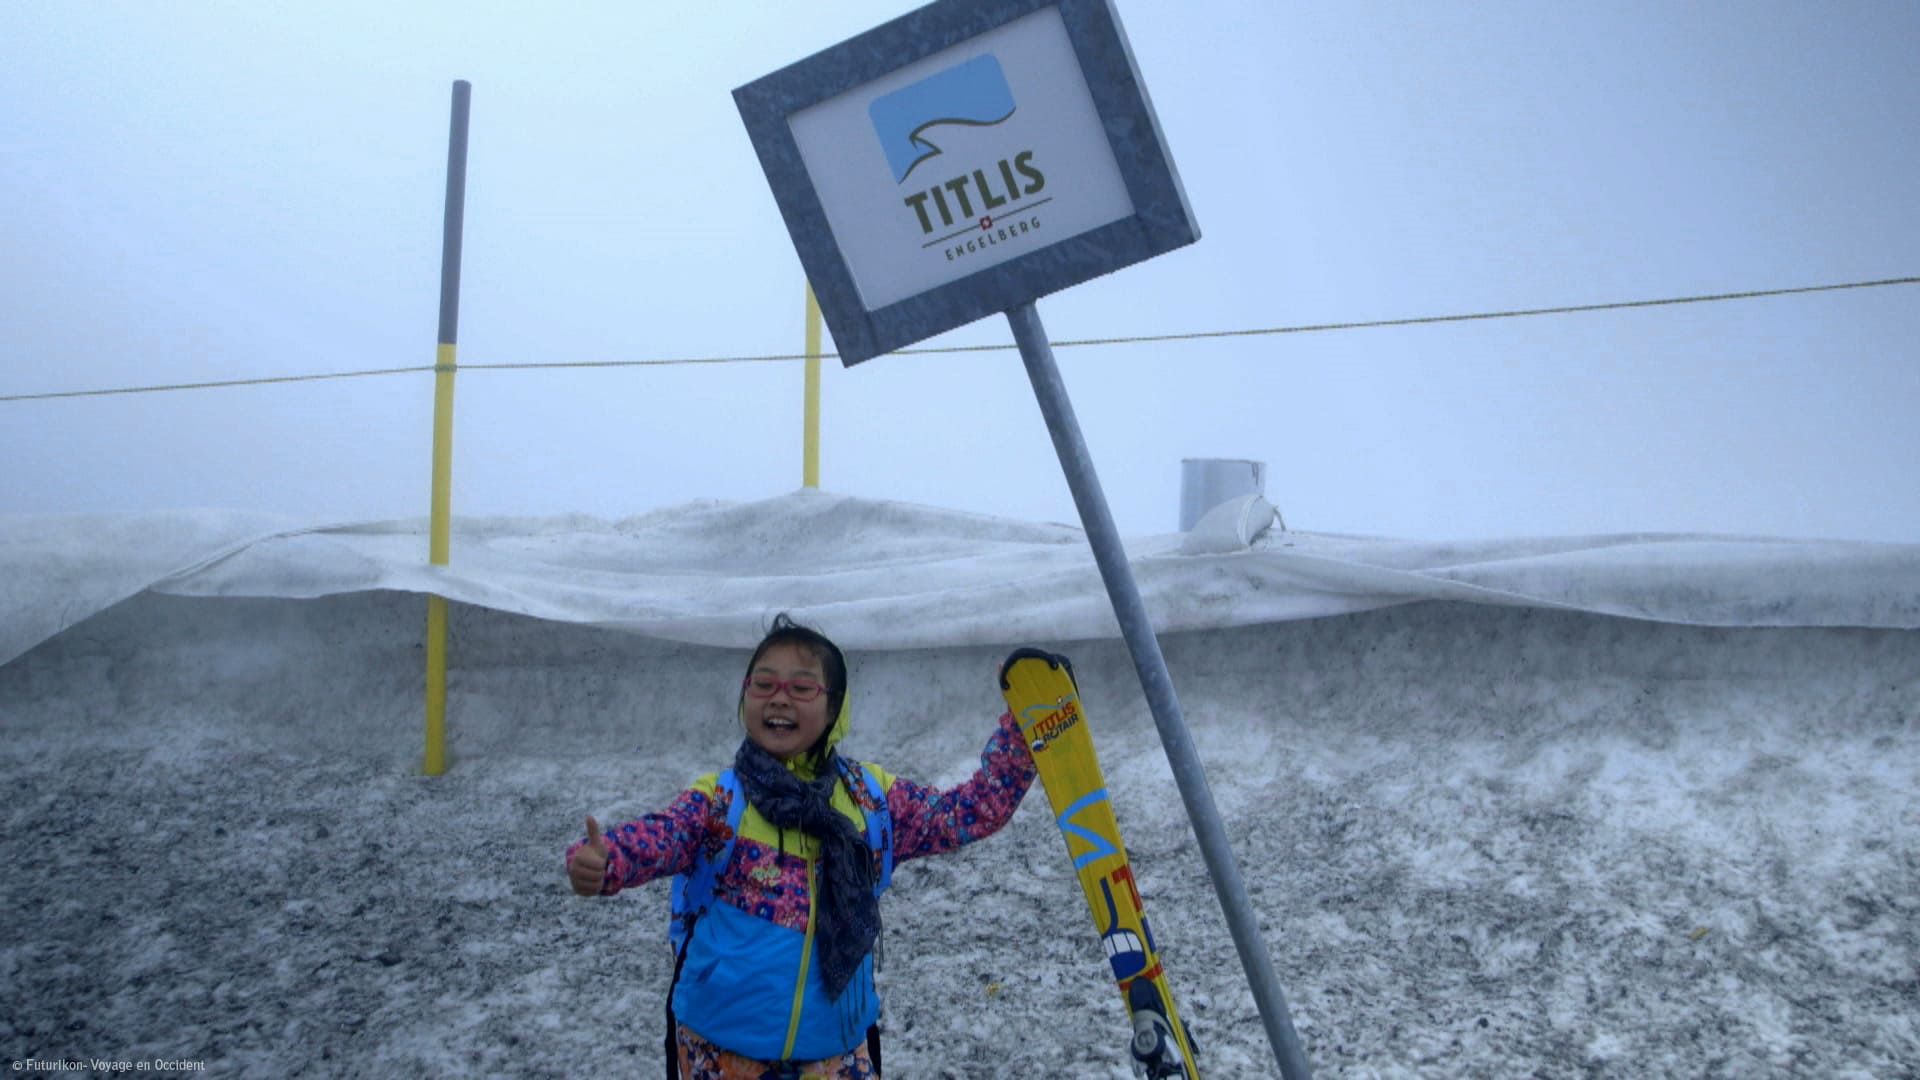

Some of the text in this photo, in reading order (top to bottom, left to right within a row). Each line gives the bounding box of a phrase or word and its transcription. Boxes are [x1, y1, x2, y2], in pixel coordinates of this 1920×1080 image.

[904, 150, 1045, 235] TITLIS
[945, 216, 1041, 261] ENGELBERG
[1036, 702, 1075, 734] TITLIS
[1043, 713, 1079, 744] ROTAIR
